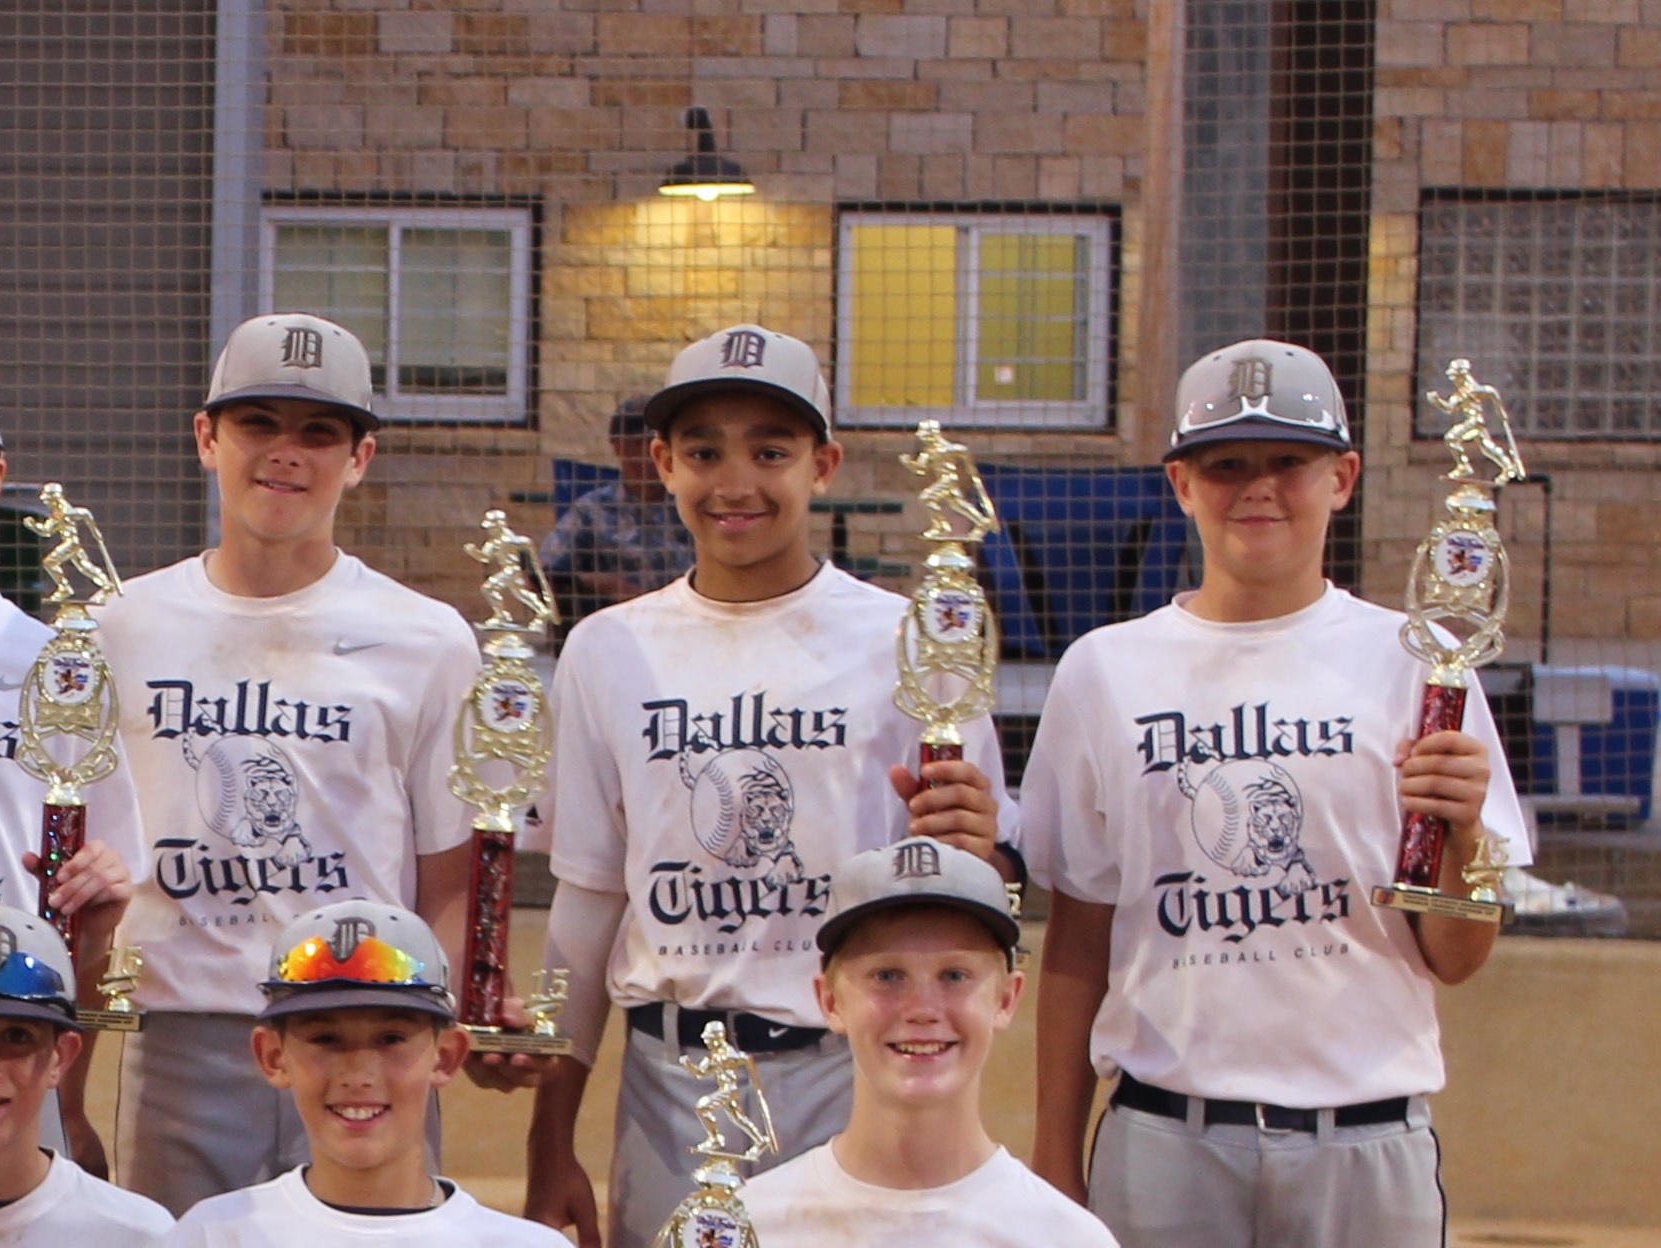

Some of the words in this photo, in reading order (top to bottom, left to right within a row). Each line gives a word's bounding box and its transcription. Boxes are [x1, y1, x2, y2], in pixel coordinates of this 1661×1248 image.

[281, 326, 324, 368] D
[721, 330, 767, 369] D
[1228, 358, 1272, 403] D
[145, 678, 353, 744] Dallas
[642, 691, 848, 763] Dallas
[1134, 702, 1354, 775] Dallas
[154, 838, 349, 905] Tigers
[891, 841, 940, 880] D
[1470, 836, 1510, 866] 15
[648, 860, 831, 933] Tigers
[1154, 872, 1350, 943] Tigers
[179, 913, 270, 928] BSEBAL
[658, 941, 760, 956] BASEBAL
[774, 940, 812, 952] CLU
[1294, 943, 1350, 959] CLUB
